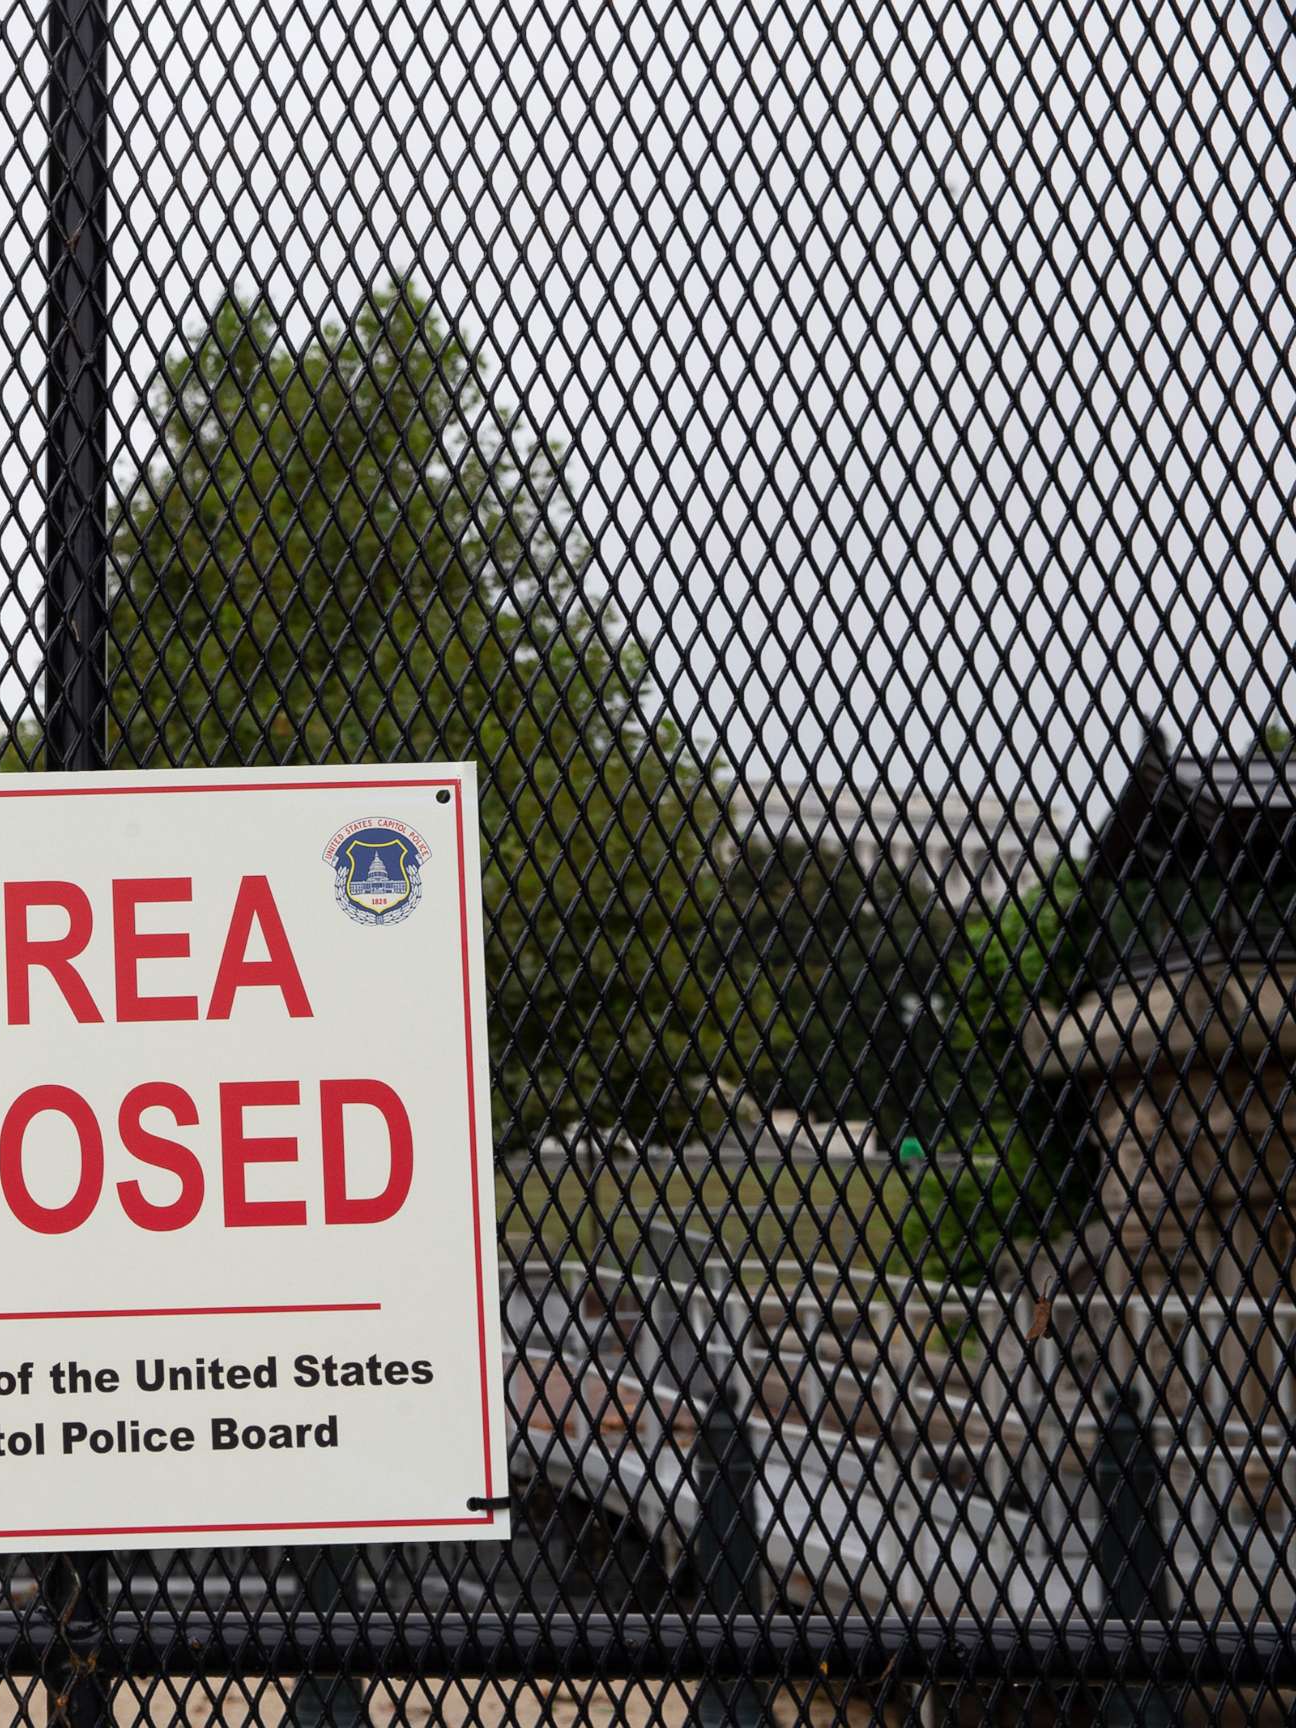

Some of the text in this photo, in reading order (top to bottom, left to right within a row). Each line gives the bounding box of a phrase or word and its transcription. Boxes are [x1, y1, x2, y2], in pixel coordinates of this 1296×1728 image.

[325, 819, 429, 860] UNITED STATES CAPITOL POLICE
[50, 1362, 119, 1394] the
[136, 1356, 277, 1391] United
[294, 1354, 433, 1387] States
[63, 1421, 194, 1454] Police
[212, 1415, 338, 1450] Board
